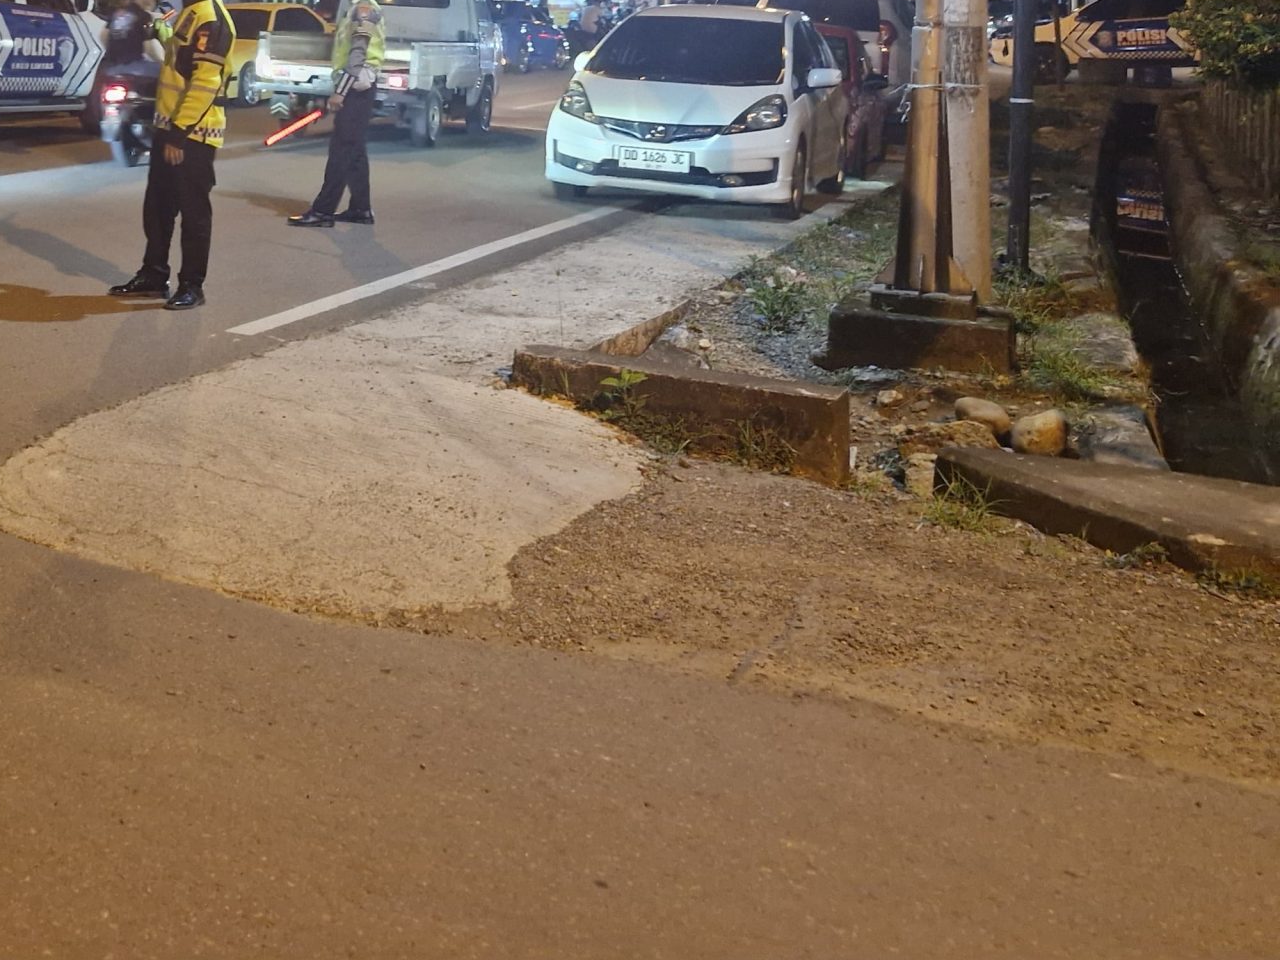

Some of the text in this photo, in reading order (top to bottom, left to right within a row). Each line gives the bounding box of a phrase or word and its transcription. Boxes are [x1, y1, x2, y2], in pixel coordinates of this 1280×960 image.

[1117, 30, 1166, 41] POLISI
[14, 37, 56, 56] POLISI
[624, 149, 637, 160] DD
[642, 151, 667, 163] 1626
